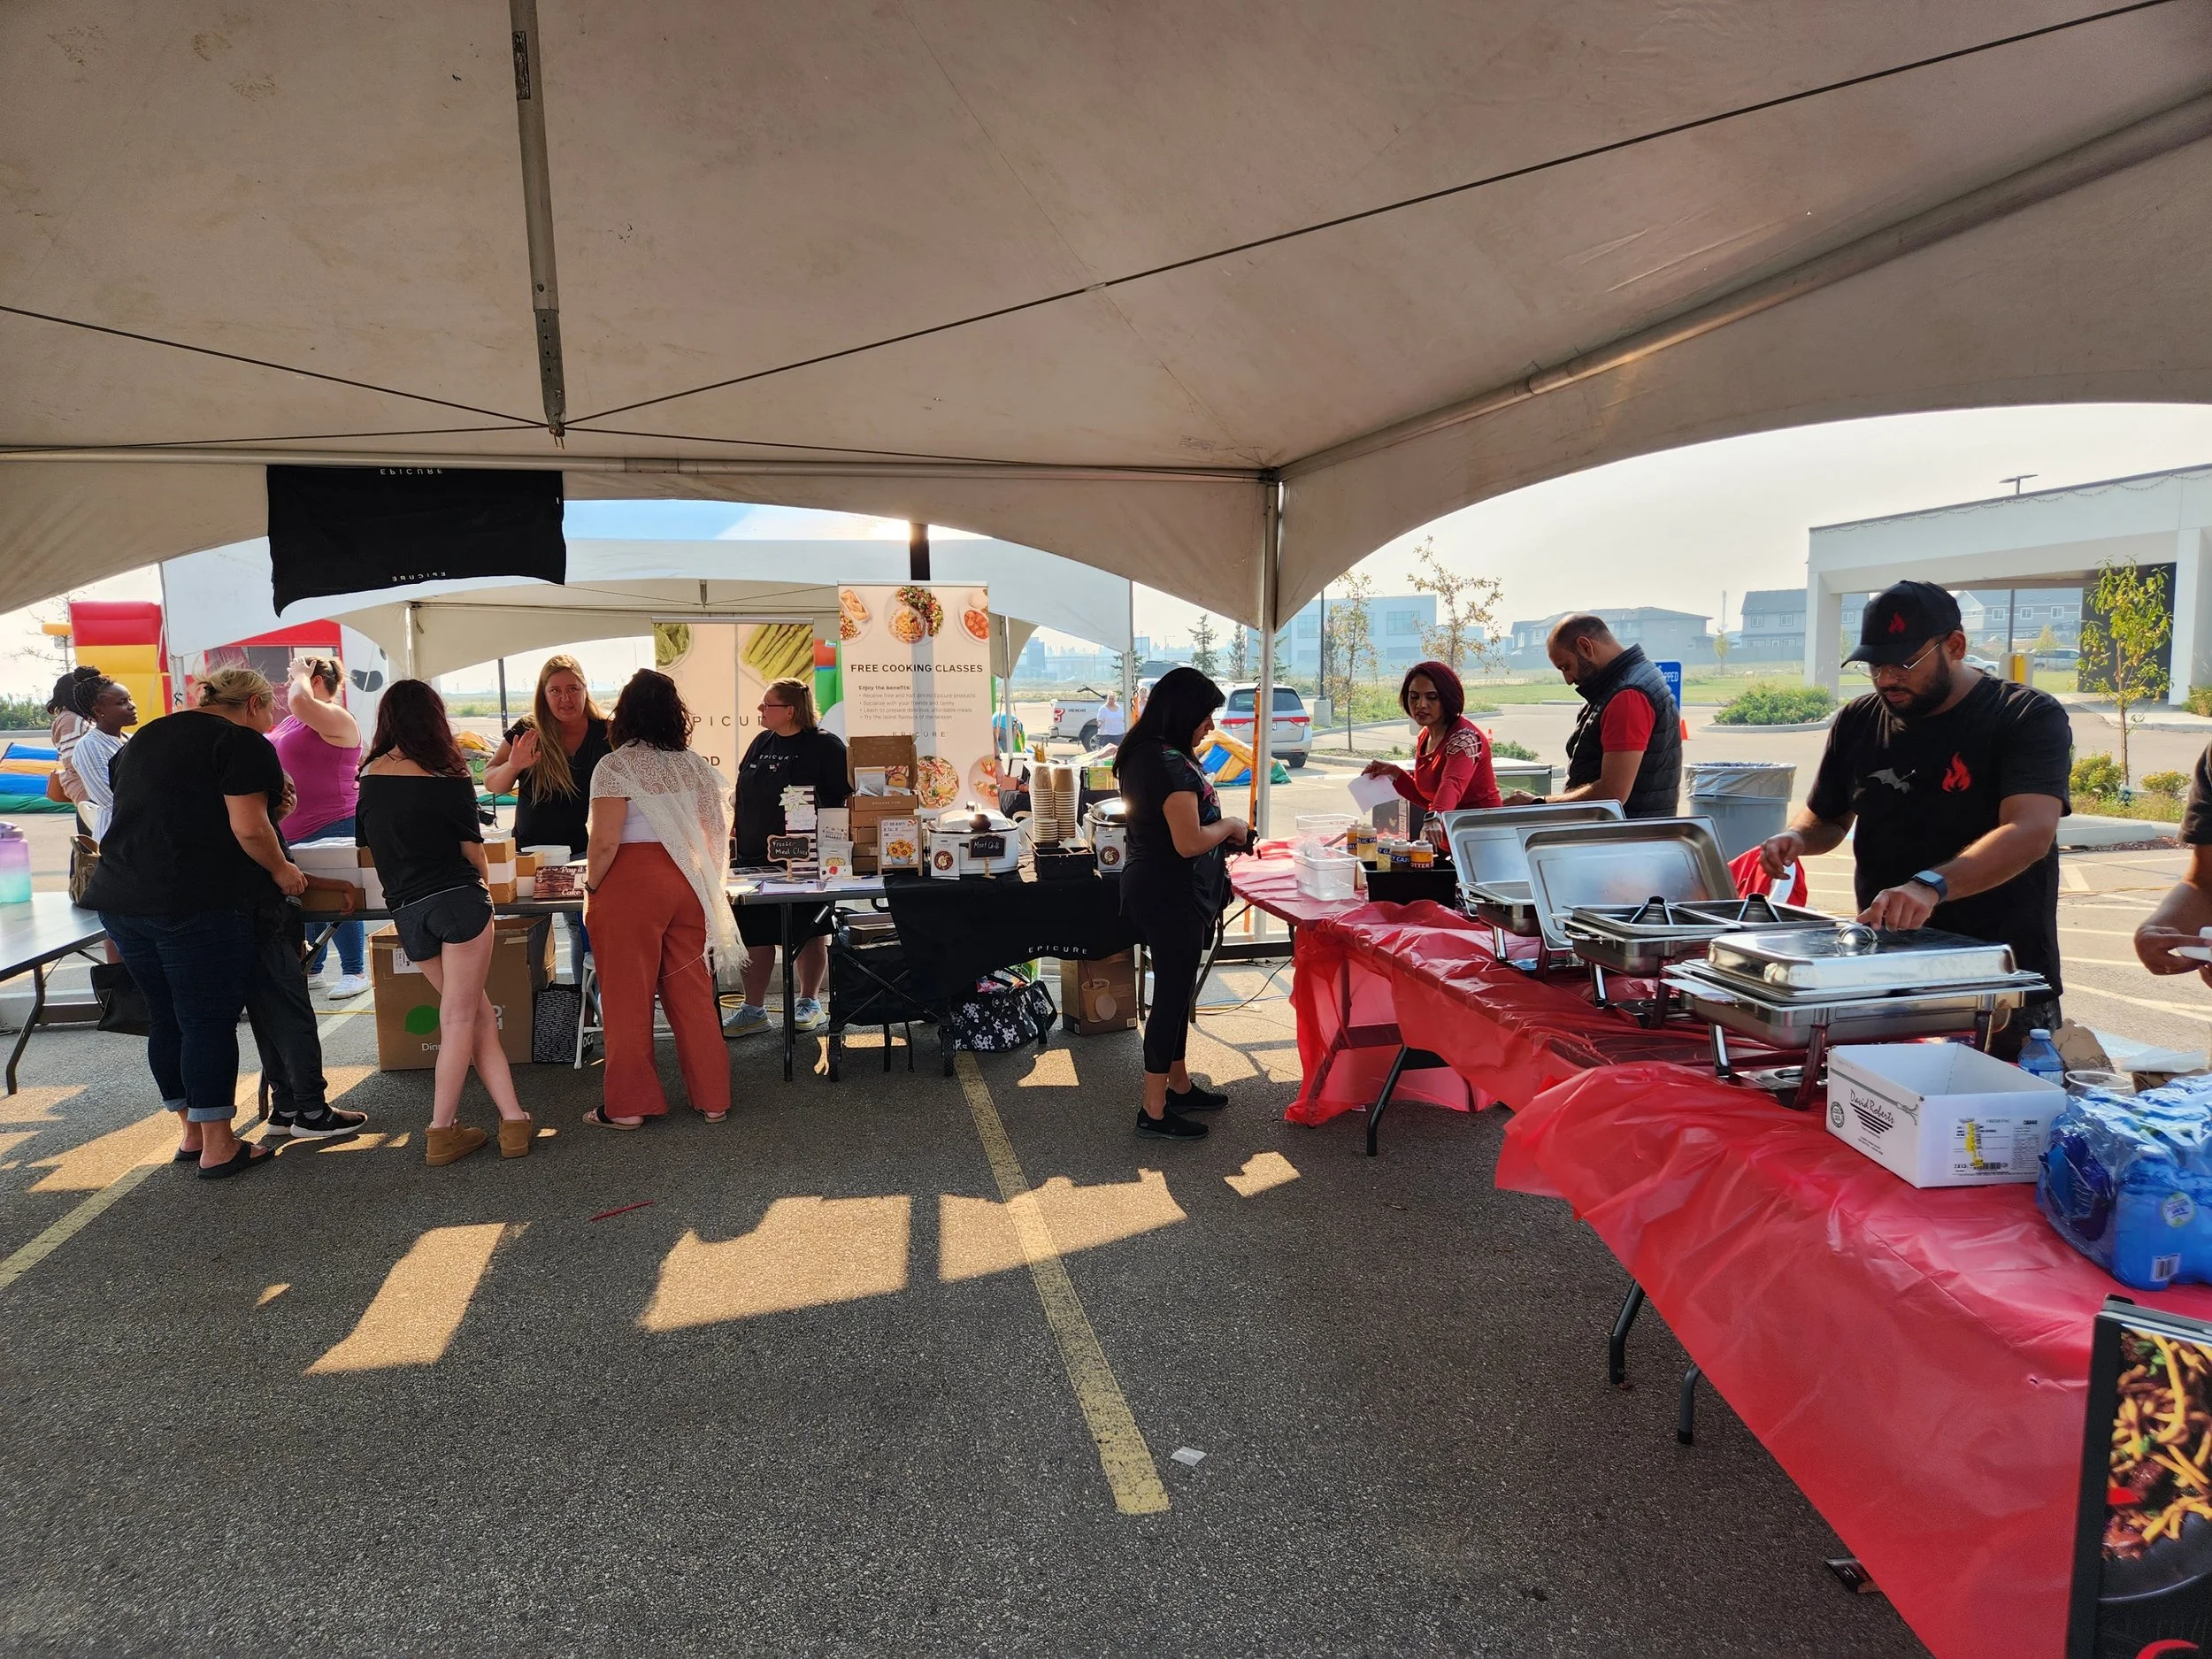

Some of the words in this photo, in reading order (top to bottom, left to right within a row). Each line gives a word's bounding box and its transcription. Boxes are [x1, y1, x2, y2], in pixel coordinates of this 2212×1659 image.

[850, 664, 879, 672] FREE
[881, 664, 933, 672] COOKING
[792, 846, 808, 856] Class
[560, 866, 577, 876] Pay
[1028, 945, 1087, 955] EPICURE
